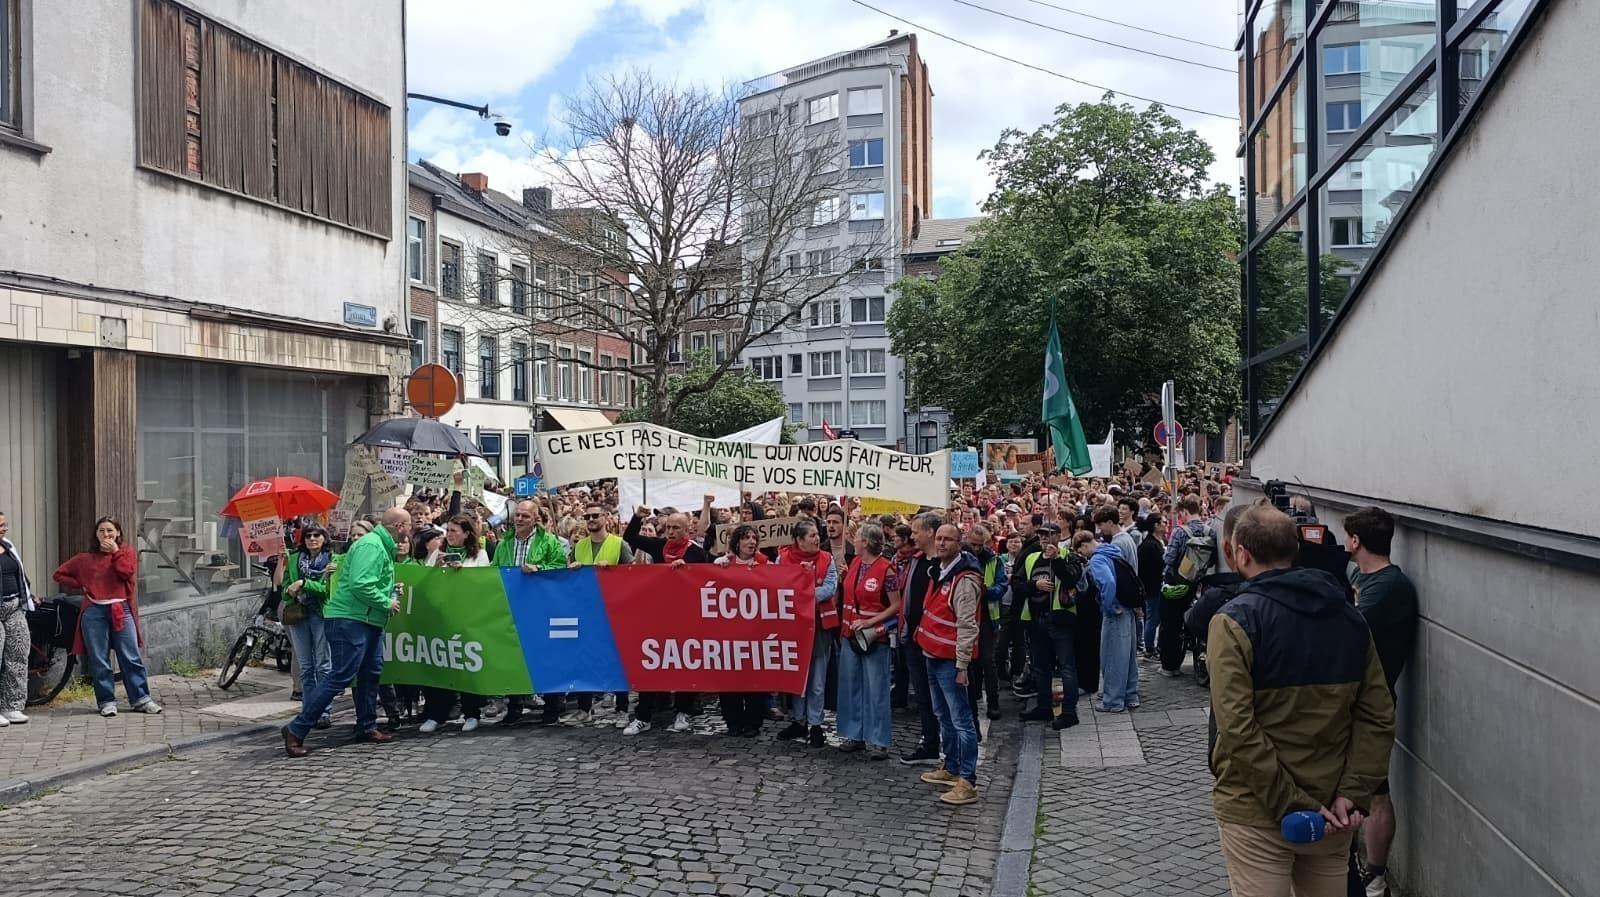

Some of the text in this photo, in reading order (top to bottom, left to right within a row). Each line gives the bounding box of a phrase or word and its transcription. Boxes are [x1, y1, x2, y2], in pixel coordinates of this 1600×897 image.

[547, 436, 573, 455] CE
[578, 430, 625, 450] N'EST
[632, 429, 662, 447] PAS
[668, 434, 689, 452] LE
[696, 439, 758, 459] TRAVAIL
[765, 445, 792, 461] QUI
[798, 445, 843, 462] NOUS
[849, 446, 882, 467] FAIT
[888, 455, 934, 476] PEUR,
[519, 481, 526, 492] P
[613, 453, 880, 491] C'EST L'AVENIR DE VOS ENFANTS!
[700, 581, 795, 620] ÉCOLE
[641, 633, 799, 671] SACRIFIÉE
